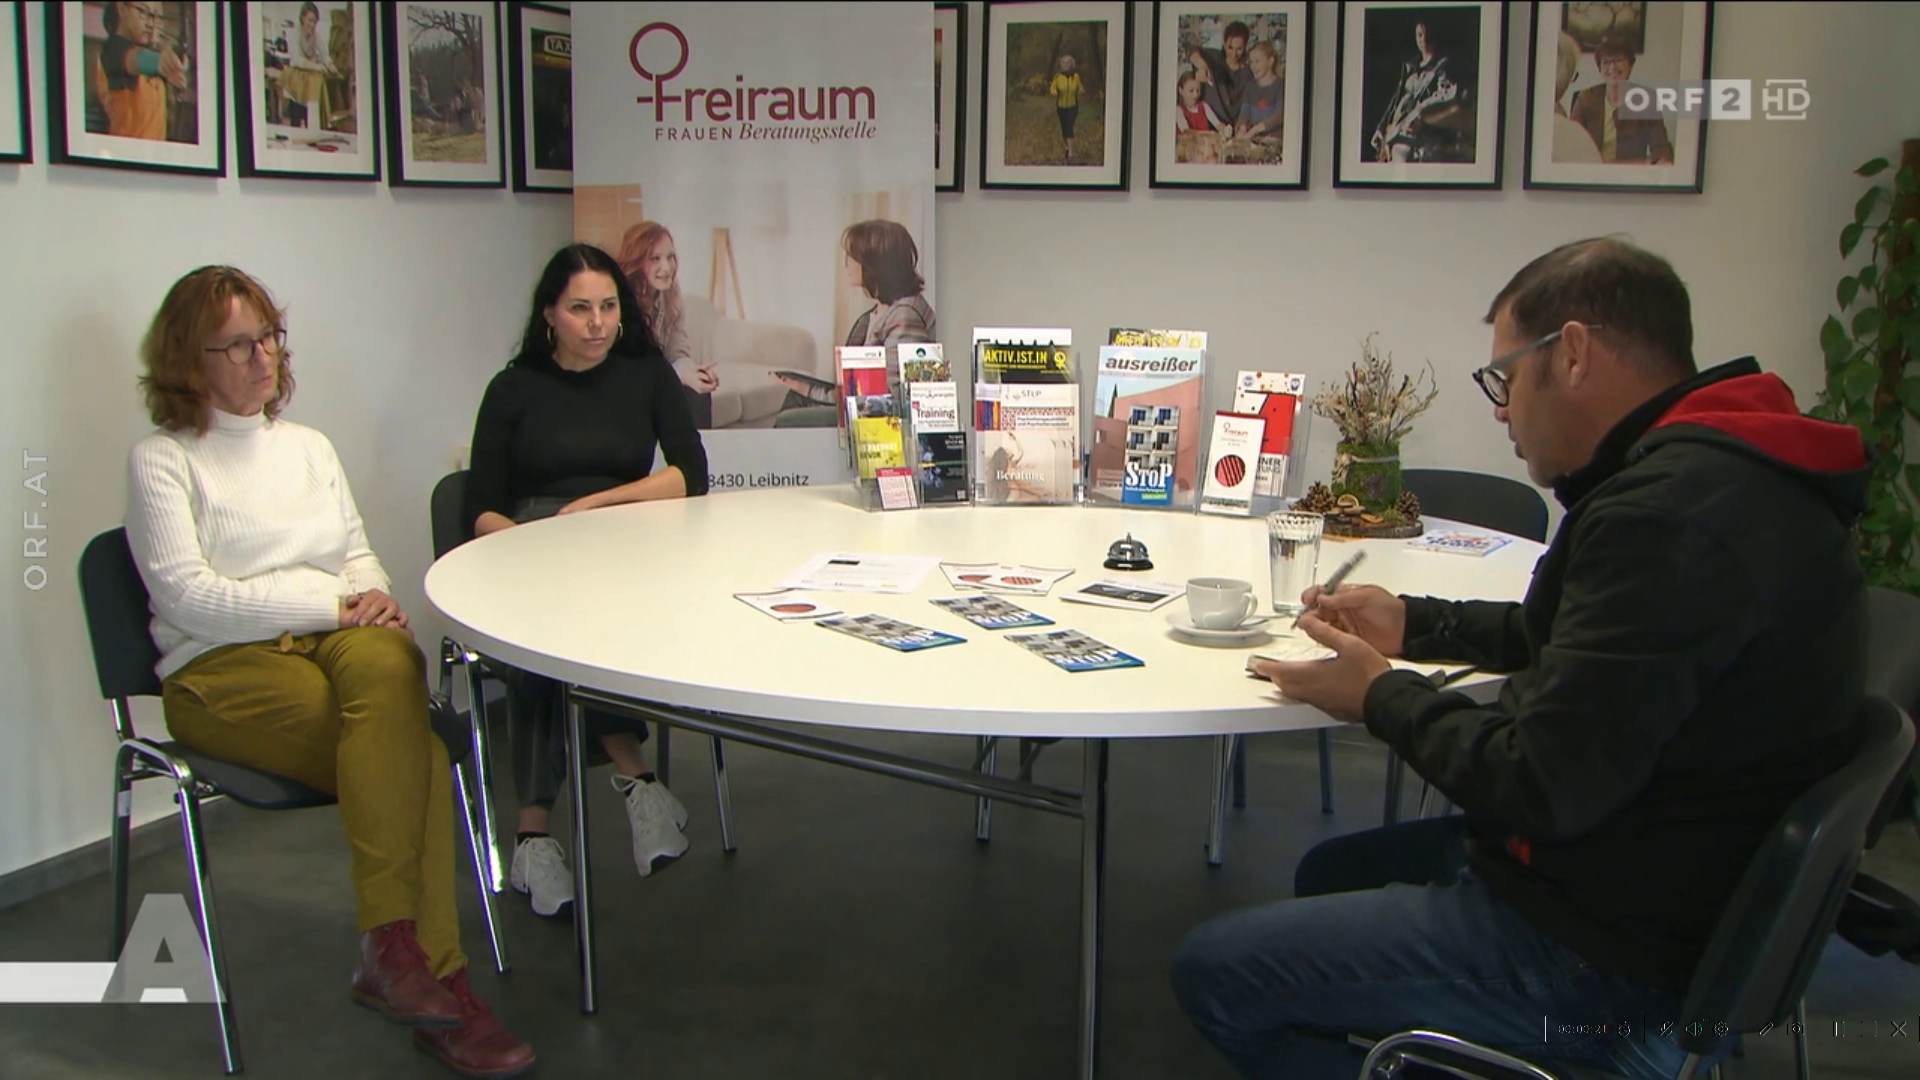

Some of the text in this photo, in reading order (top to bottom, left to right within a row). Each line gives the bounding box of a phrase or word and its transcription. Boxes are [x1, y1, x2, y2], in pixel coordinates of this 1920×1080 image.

[637, 70, 876, 122] Freiraum
[655, 121, 877, 144] FRAUEN Beratungsstelle
[1105, 356, 1198, 372] ausreißer
[917, 406, 955, 420] Training
[749, 472, 809, 487] Leibnitz
